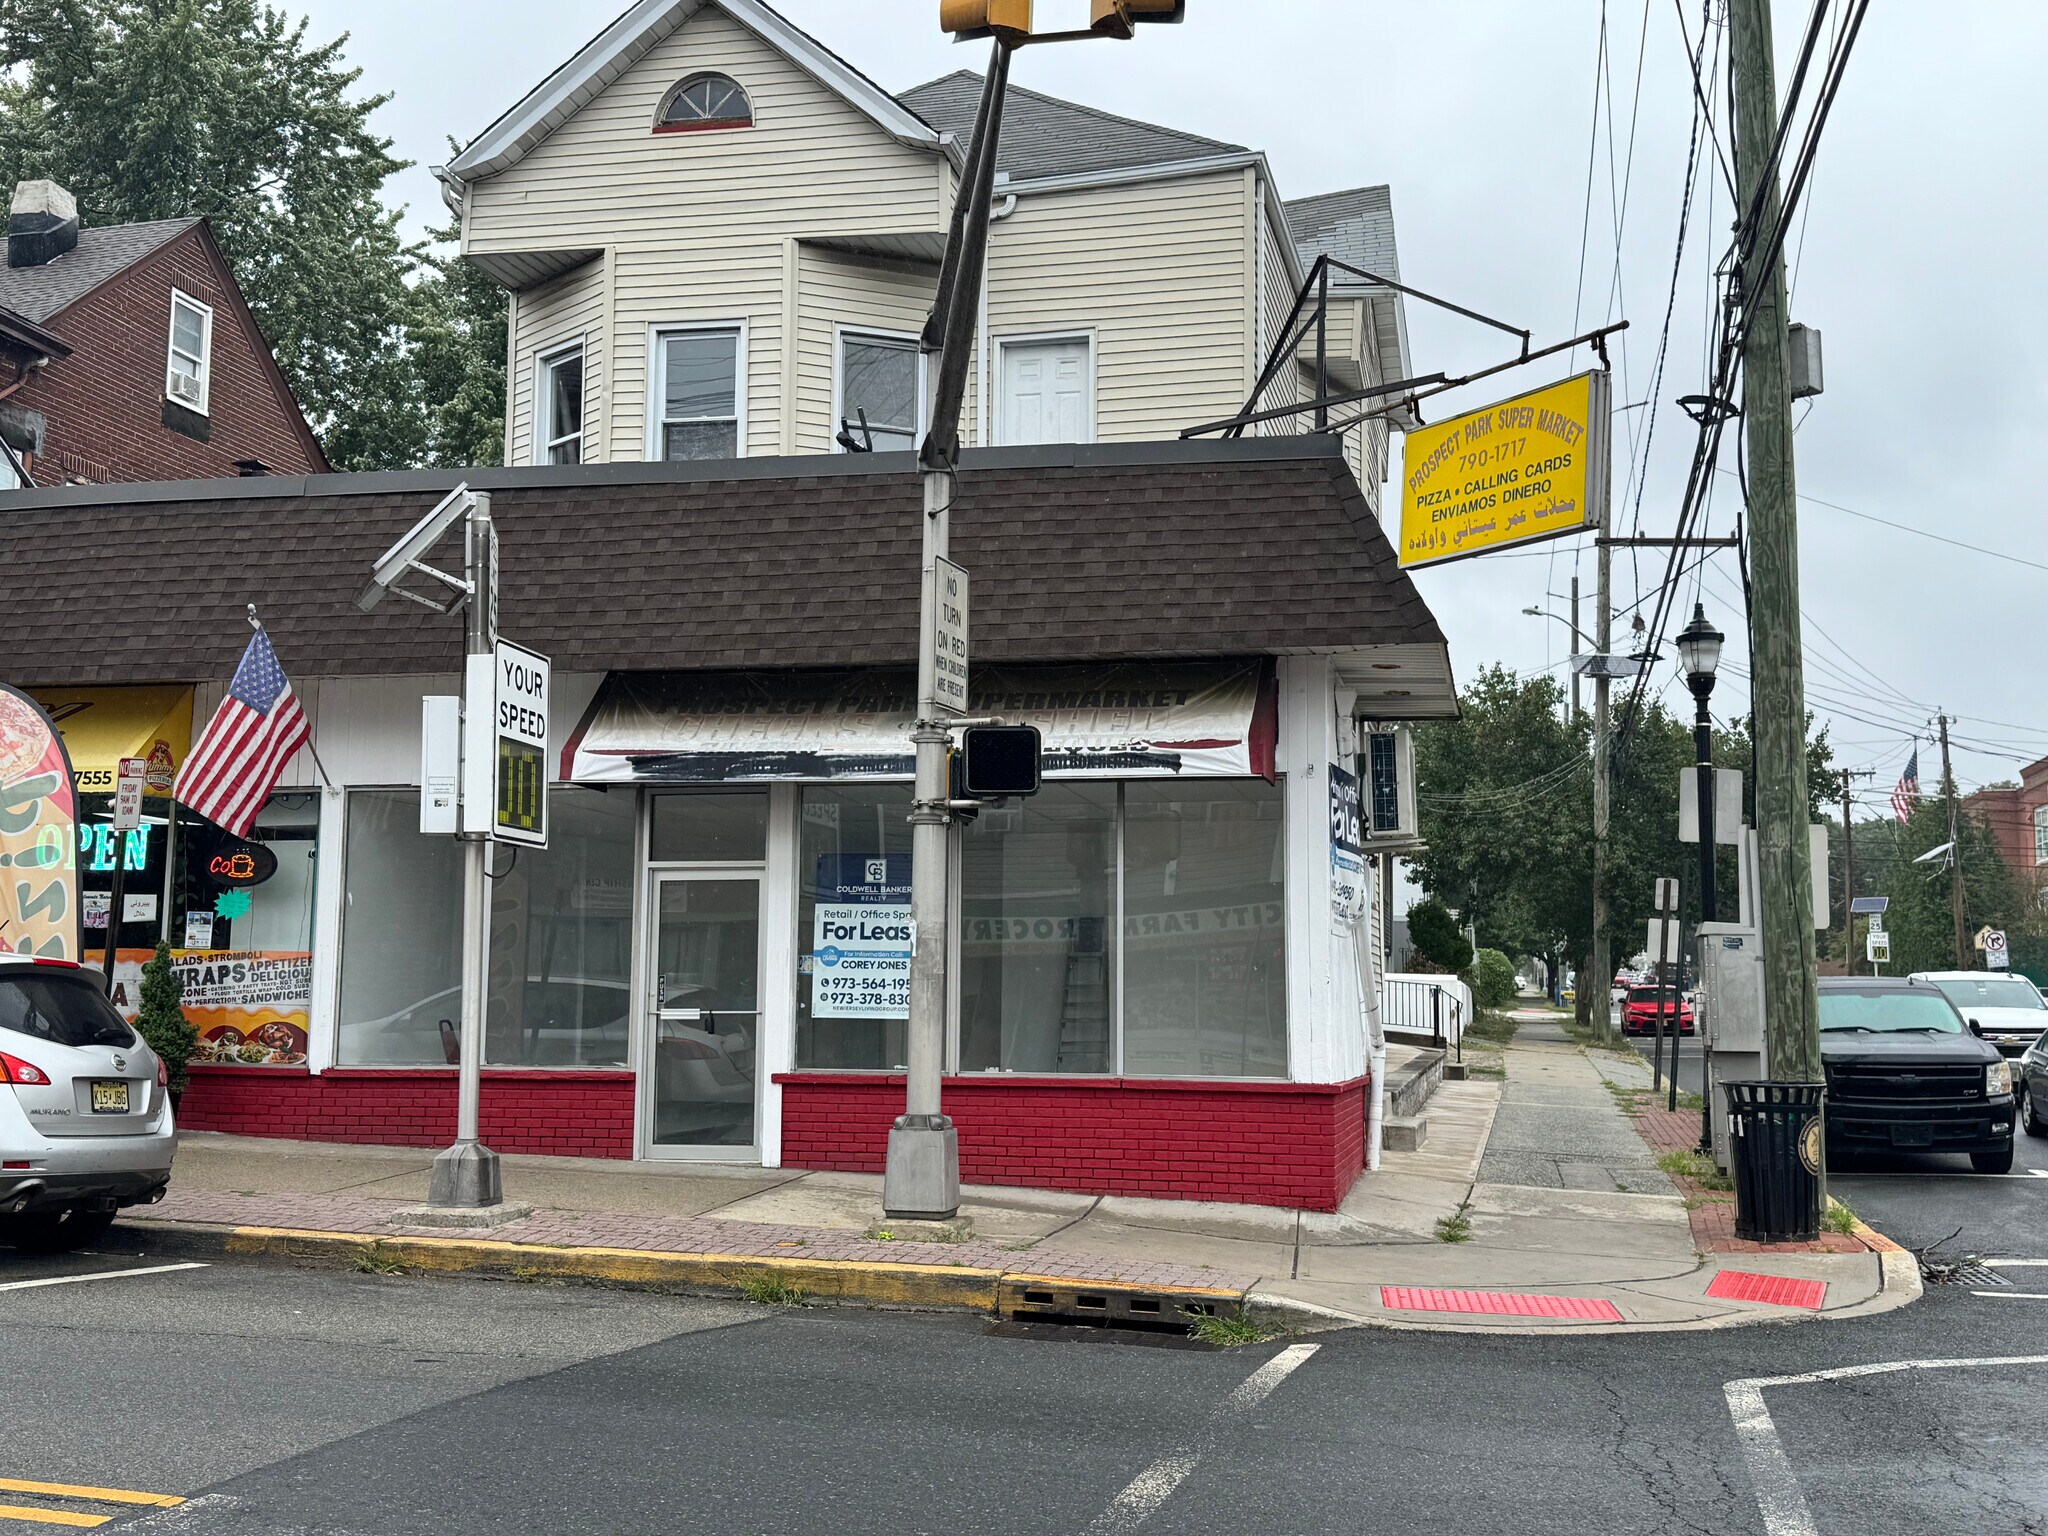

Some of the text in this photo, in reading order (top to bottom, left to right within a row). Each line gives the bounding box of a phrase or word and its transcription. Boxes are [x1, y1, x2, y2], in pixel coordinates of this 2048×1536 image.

[1409, 406, 1585, 494] PROSPECT PARK SUPER MARKET
[1459, 437, 1527, 473] 790-1717
[1417, 453, 1572, 510] PIZZA CALLING CARDS
[1431, 479, 1552, 523] ENVIAMOS DINERO
[946, 577, 957, 597] NO
[943, 603, 961, 628] TURN
[938, 630, 965, 658] ON RED
[936, 654, 966, 679] WHEN CHILDREN
[504, 659, 543, 699] YOUR
[937, 676, 964, 699] ARE PRESENT
[500, 700, 546, 740] SPEED
[120, 761, 129, 775] NO
[122, 784, 137, 793] FRIDAY
[131, 795, 137, 804] TO
[36, 823, 151, 871] OPEN
[837, 885, 912, 893] COLDWELL BANKER
[824, 910, 852, 919] Retail
[860, 910, 891, 919] Office
[893, 910, 912, 920] Spa
[823, 922, 911, 940] For Leas
[1870, 922, 1881, 930] 25
[169, 951, 262, 967] ALADS STROMBOLI
[841, 961, 876, 969] COREY
[833, 978, 911, 989] 973-564-195
[195, 996, 237, 1006] PERFECTION
[241, 989, 311, 1004] SANDWICHE
